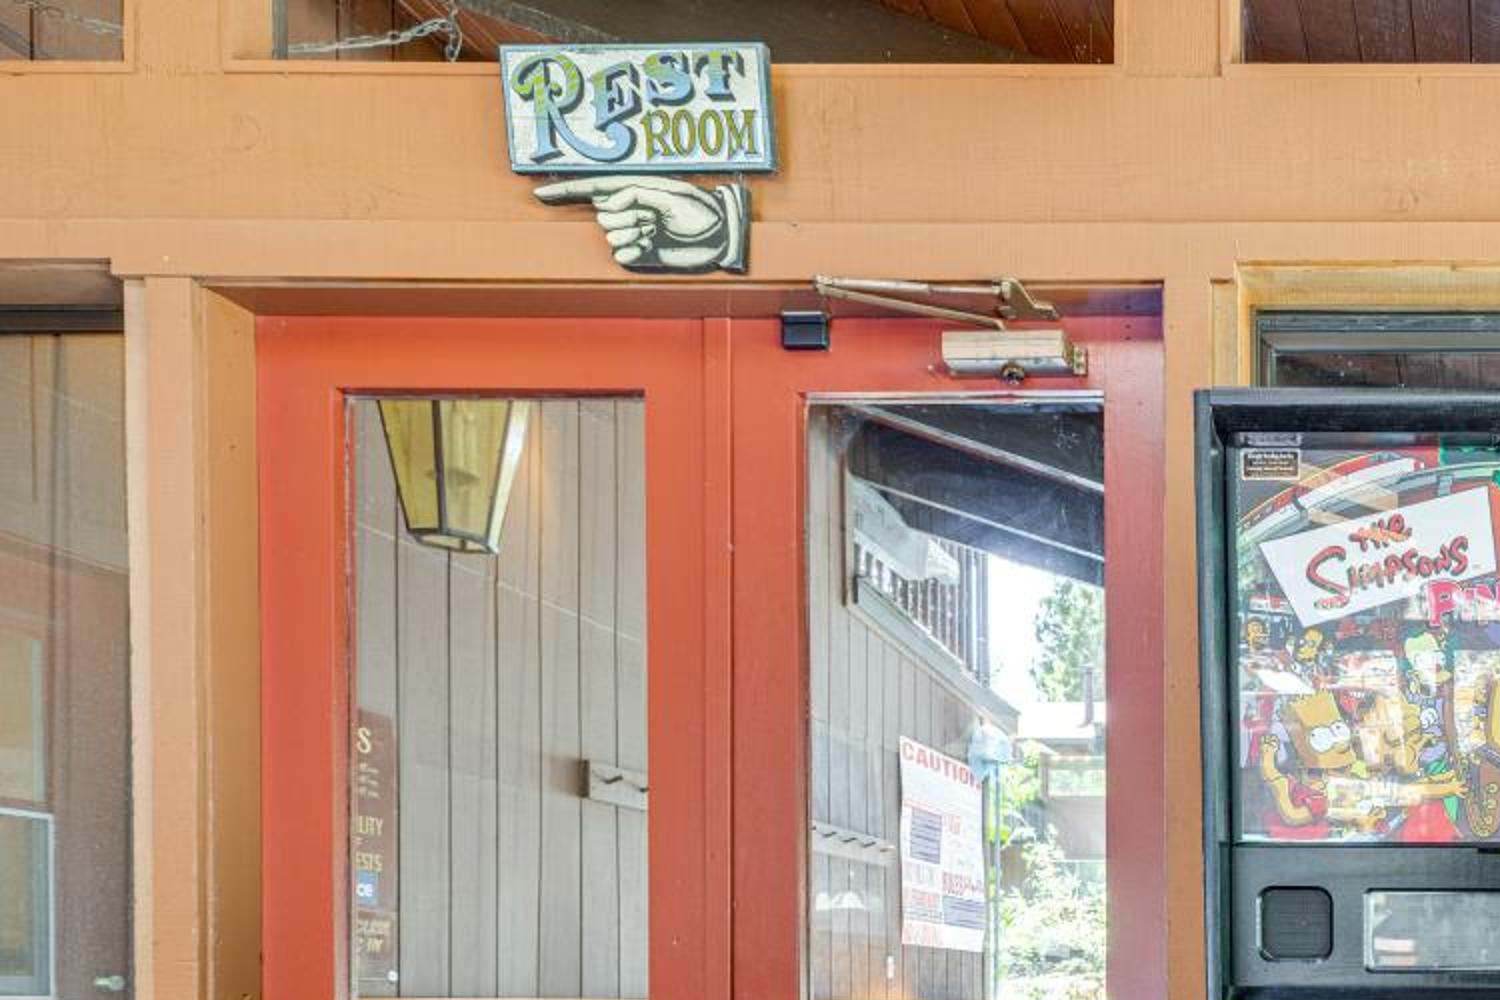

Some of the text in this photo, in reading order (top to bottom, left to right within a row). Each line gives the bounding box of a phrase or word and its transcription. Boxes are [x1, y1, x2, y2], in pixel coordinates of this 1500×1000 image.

[511, 50, 745, 163] REST
[641, 108, 761, 160] ROOM
[1306, 536, 1469, 609] SIMPSONS
